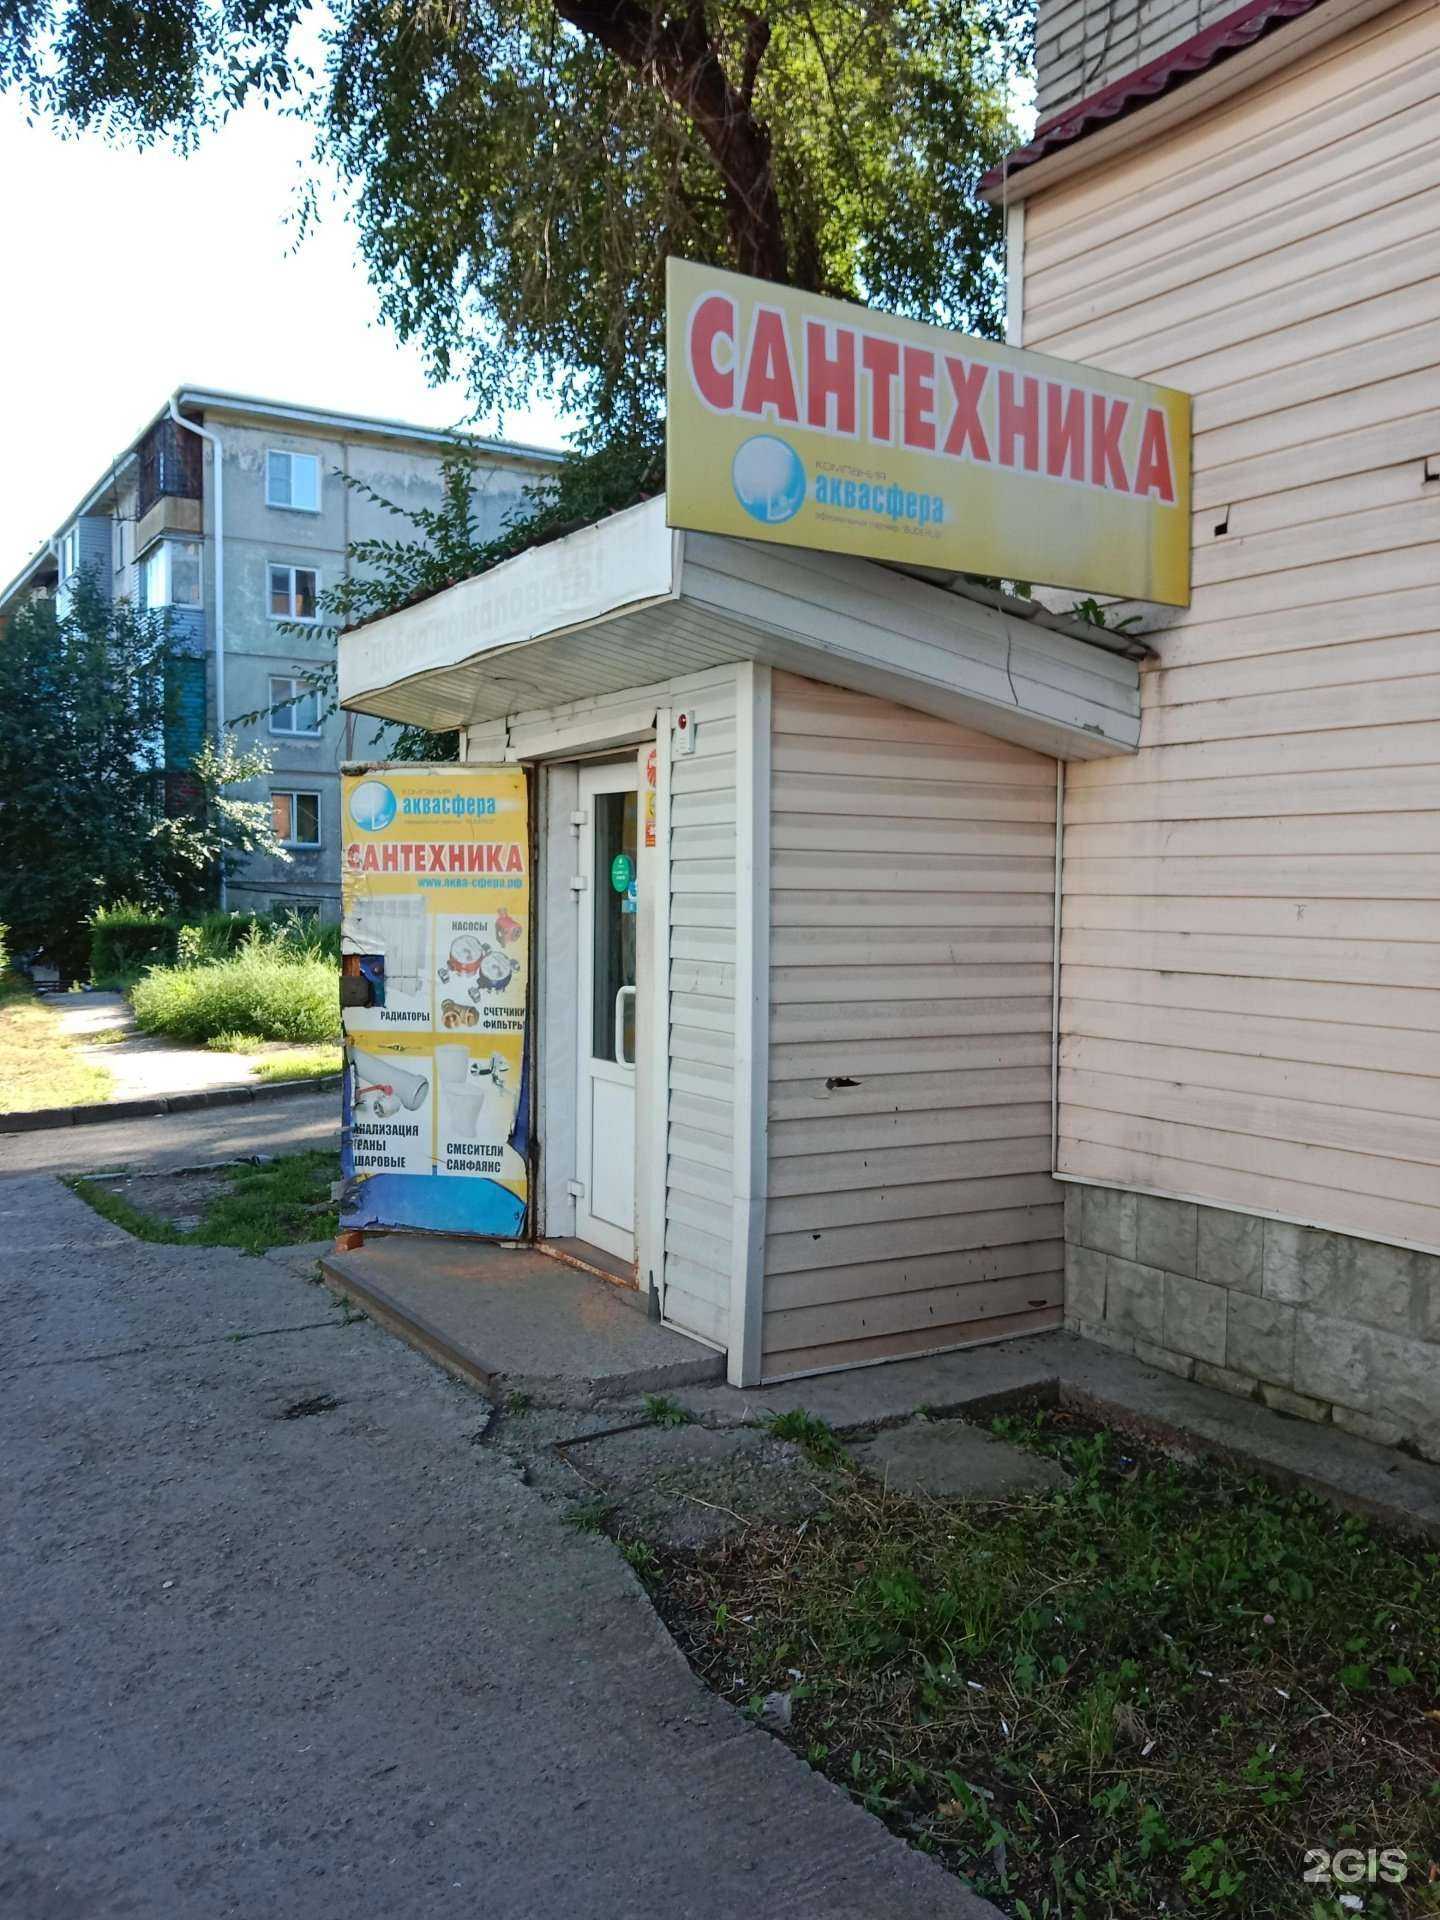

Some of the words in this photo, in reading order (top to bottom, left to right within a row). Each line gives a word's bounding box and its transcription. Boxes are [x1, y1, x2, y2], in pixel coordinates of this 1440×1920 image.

[690, 296, 1175, 503] САНТЕХНИКА
[815, 473, 945, 527] аквасфера
[402, 795, 496, 818] аквасфера
[347, 843, 523, 873] САНТЕХНИКА
[452, 920, 488, 932] НАСОСЫ
[380, 1011, 430, 1022] РАДИАТОРЫ
[352, 1123, 419, 1137] АНАЛИЗАЦИЯ
[353, 1139, 386, 1151] РАНЫ
[446, 1143, 504, 1157] СМЕСИТЕЛИ
[354, 1155, 407, 1168] ШАРОВЫЕ
[446, 1159, 501, 1173] САНФАЯНС
